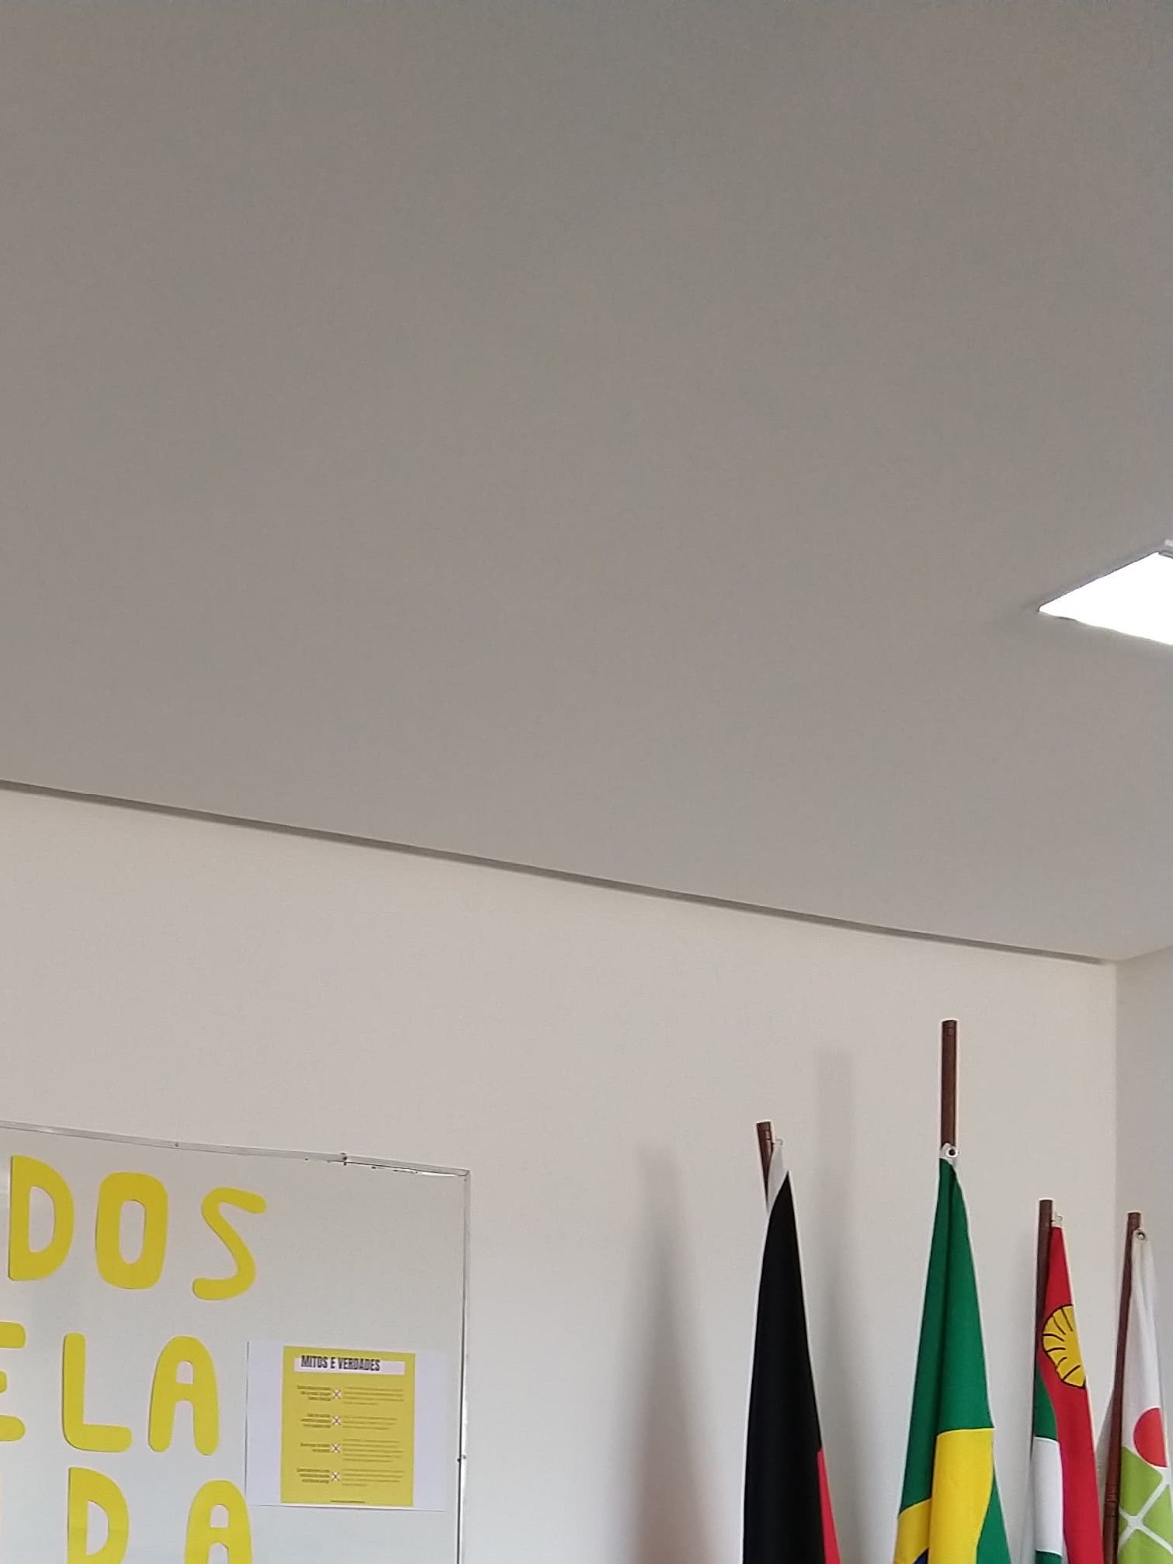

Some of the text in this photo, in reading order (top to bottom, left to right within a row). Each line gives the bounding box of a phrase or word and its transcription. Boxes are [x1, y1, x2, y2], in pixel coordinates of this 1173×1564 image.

[301, 1355, 381, 1372] MITOS E VERDADES
